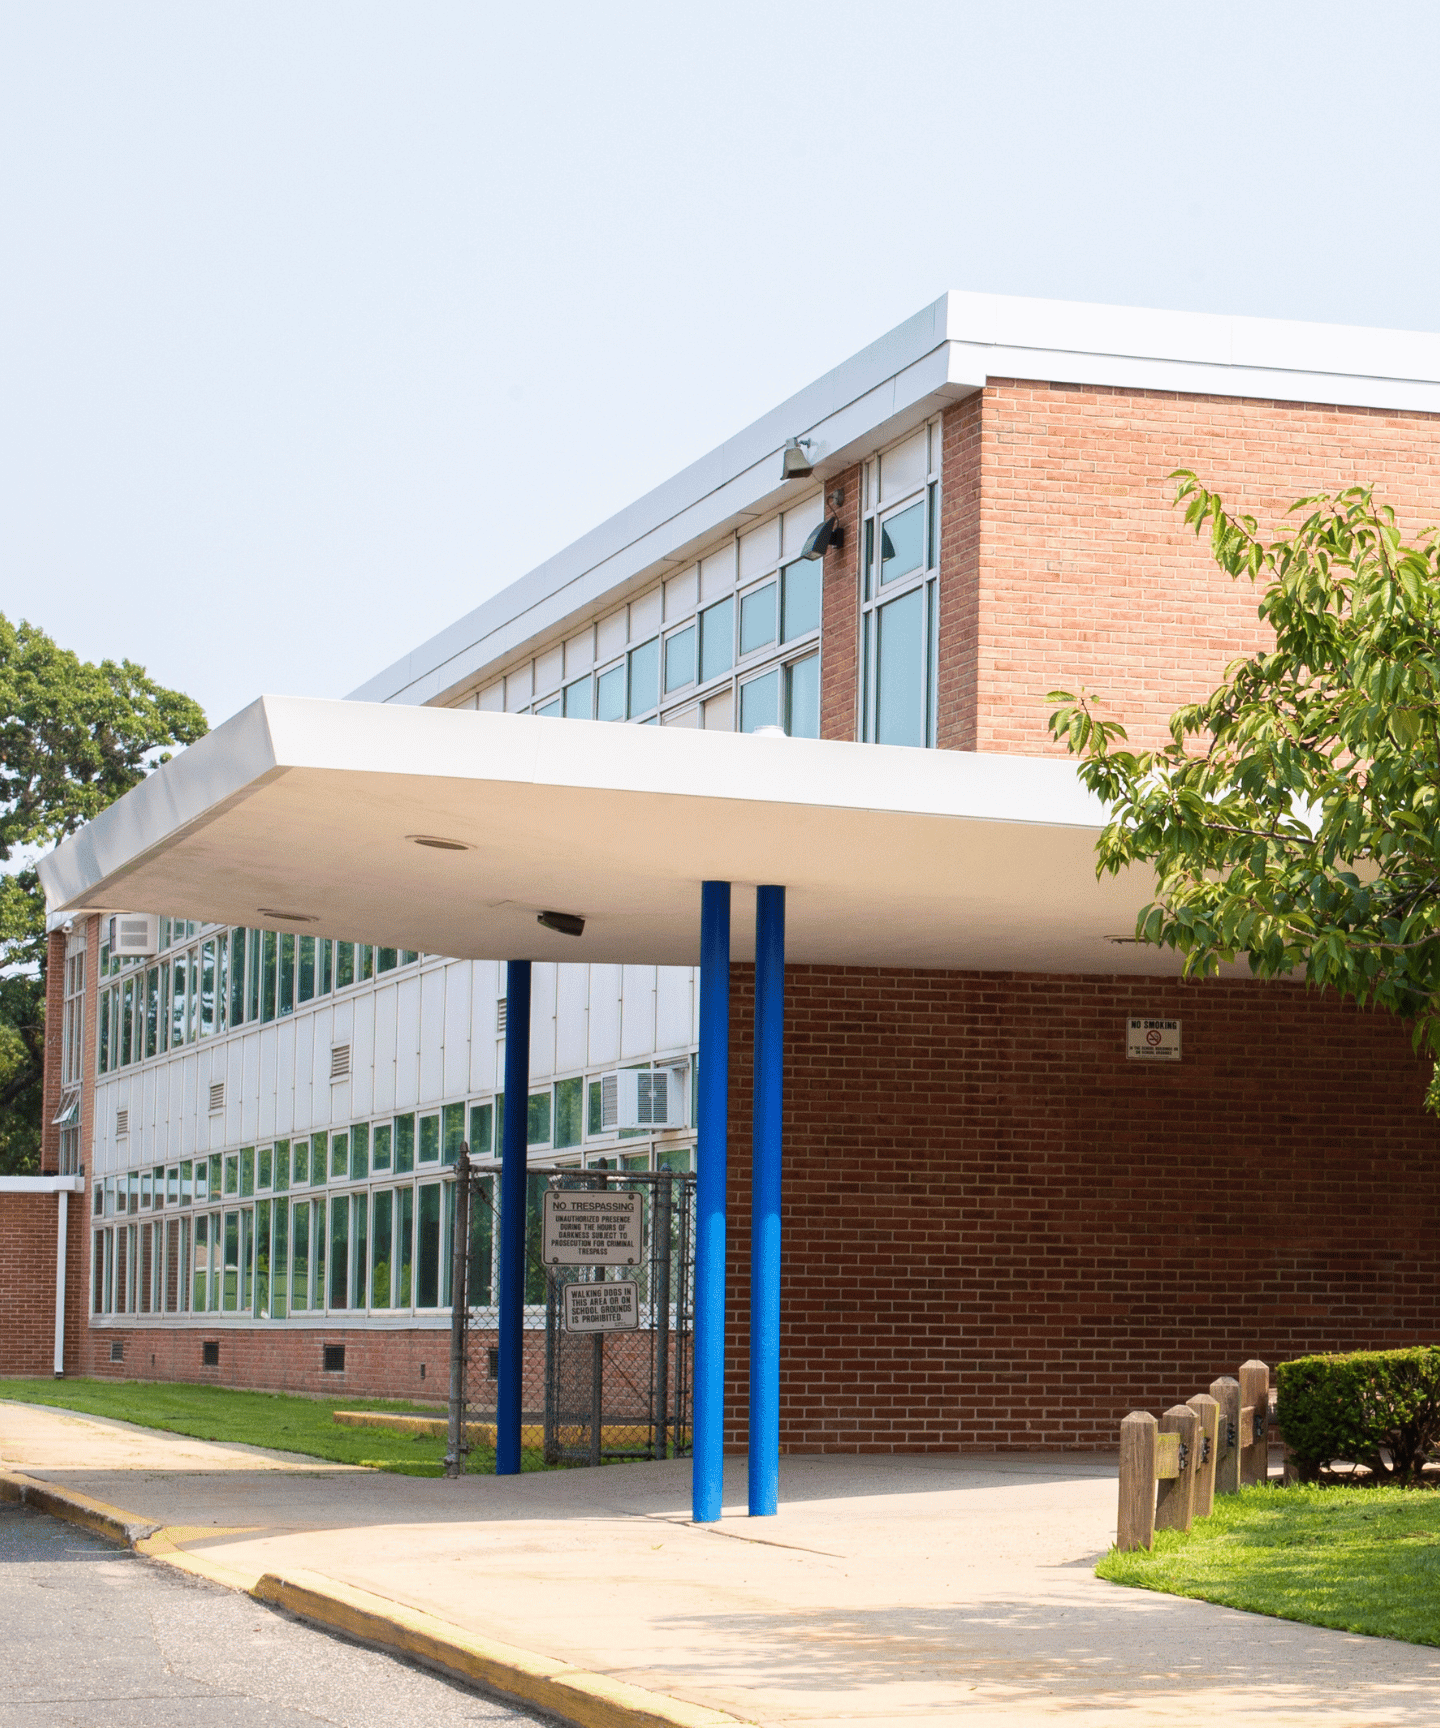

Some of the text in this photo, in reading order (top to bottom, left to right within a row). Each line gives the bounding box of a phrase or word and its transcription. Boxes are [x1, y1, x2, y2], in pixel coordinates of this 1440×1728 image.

[1131, 1020, 1177, 1029] NO SMOKING
[552, 1202, 634, 1210] NO TRESPASSING
[571, 1290, 602, 1298] WALKING
[572, 1305, 631, 1315] SCHOOL GROUNDS
